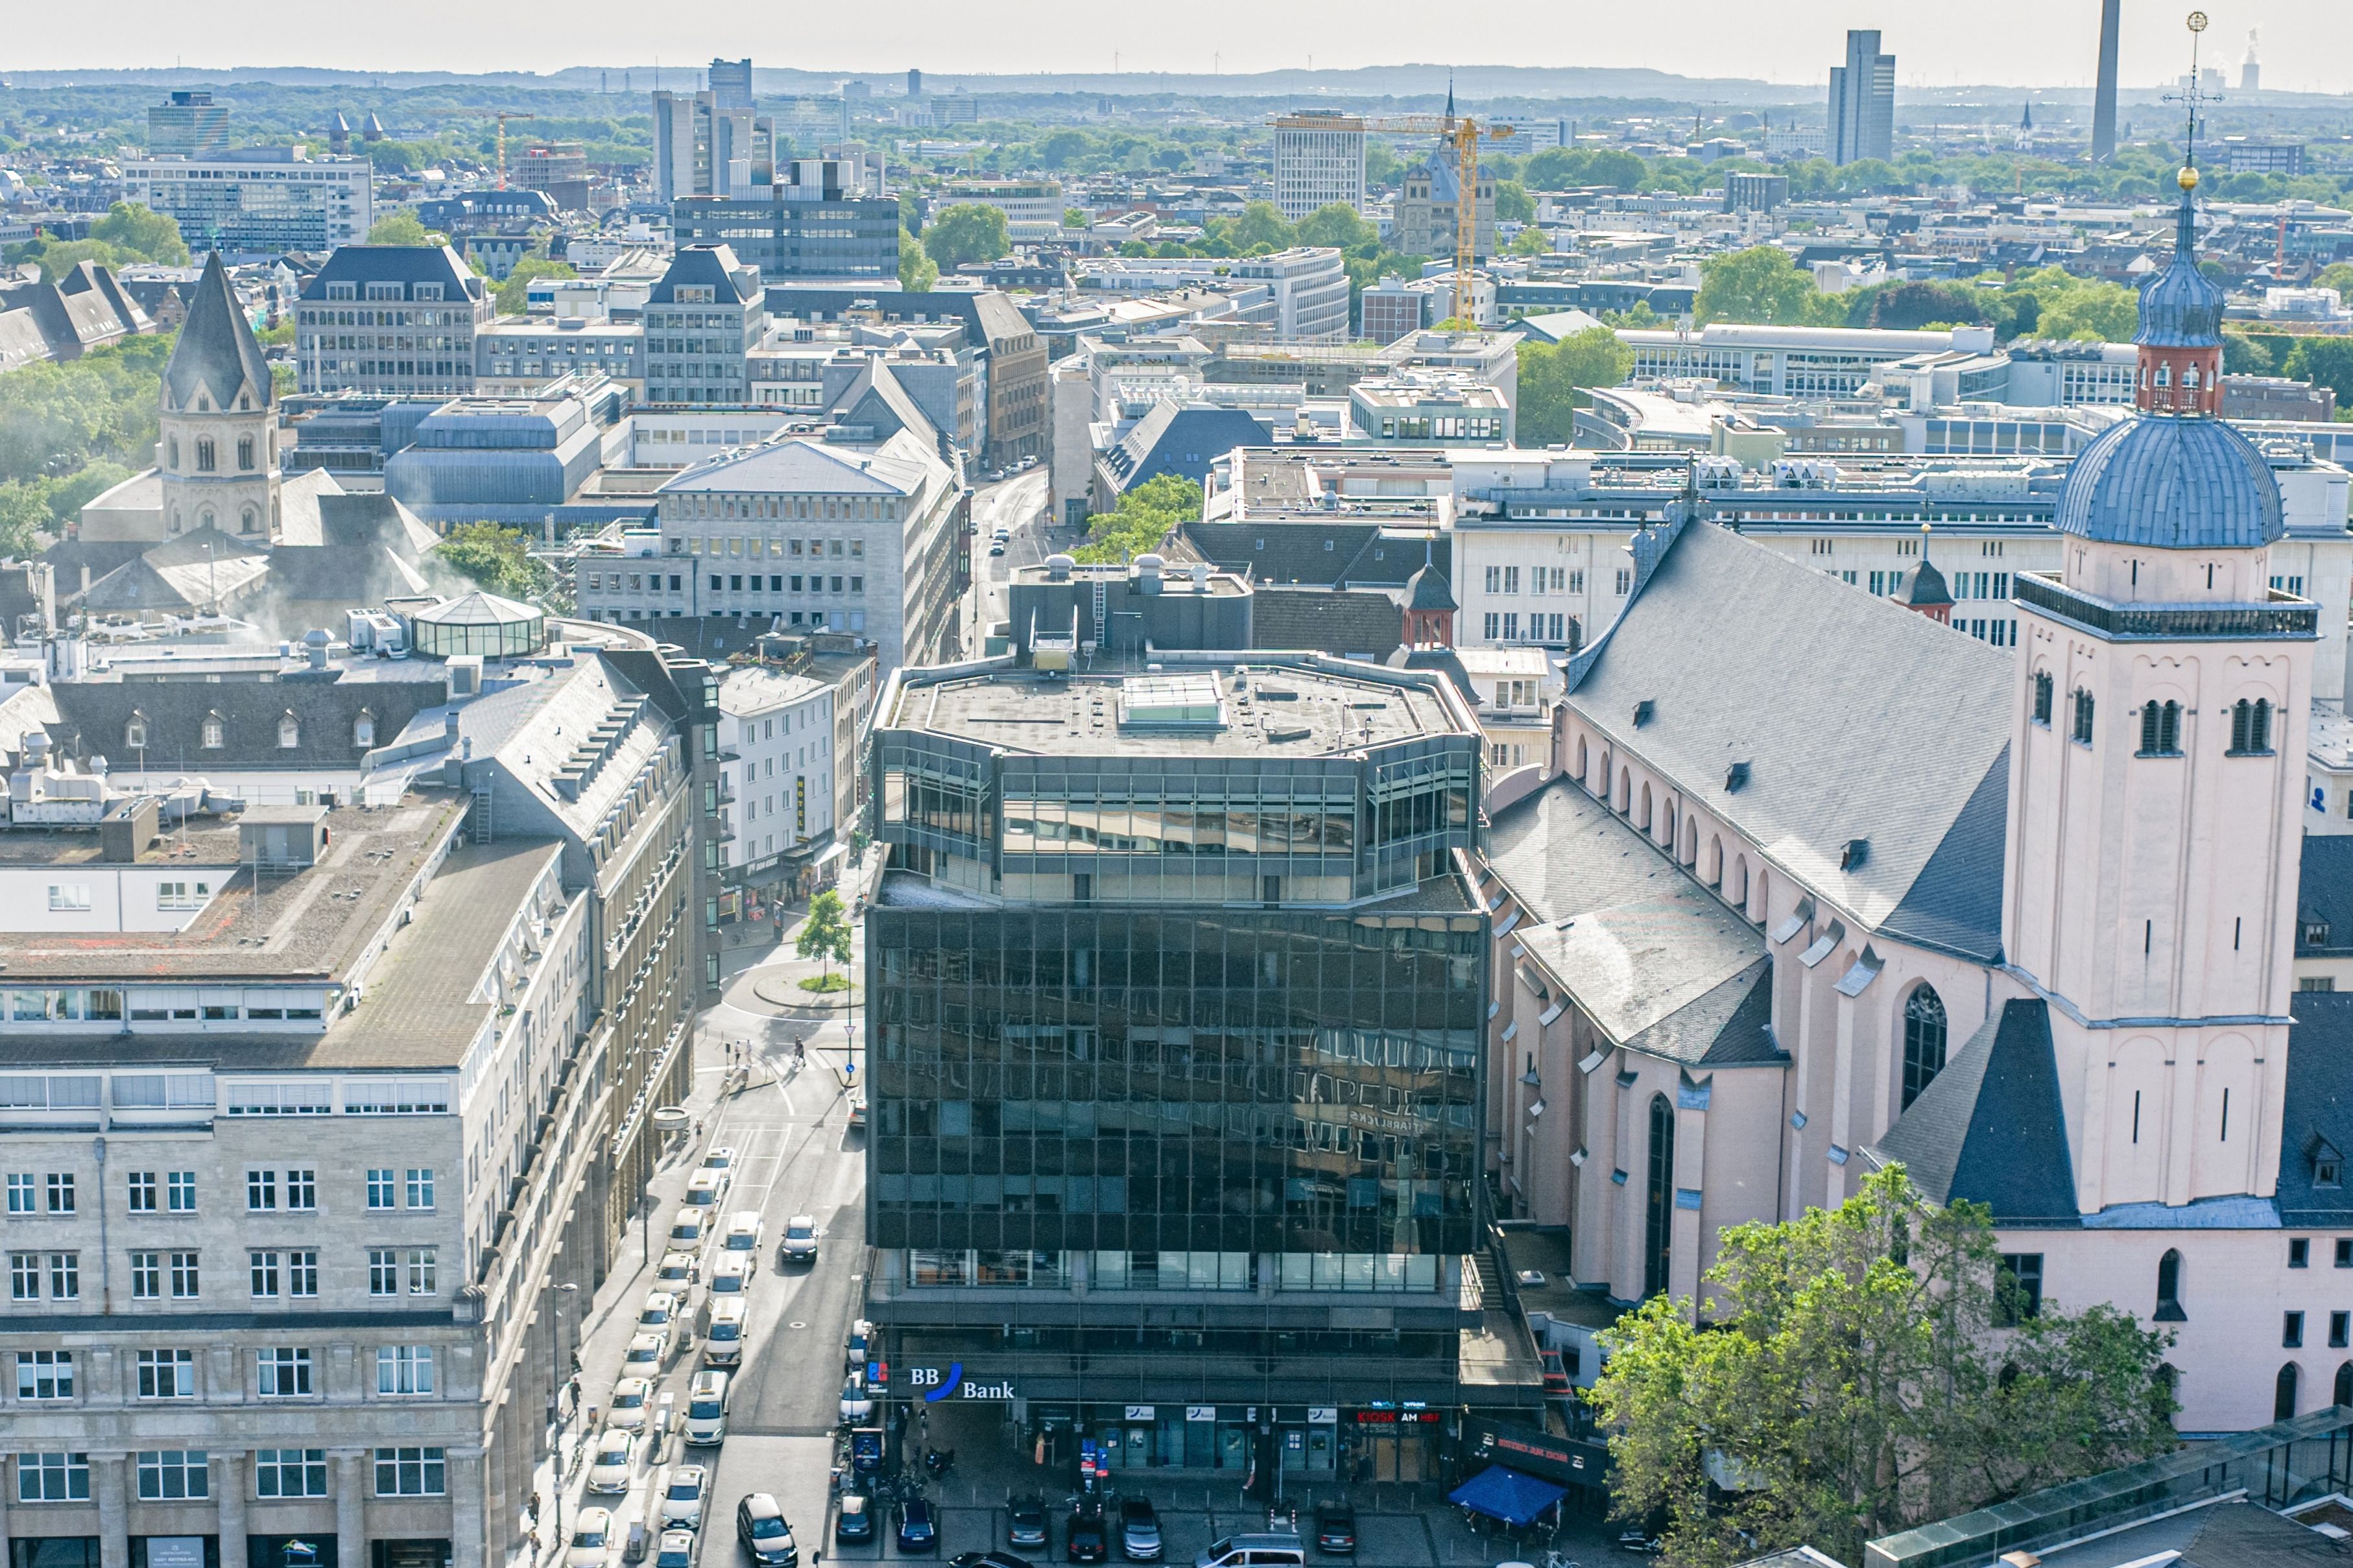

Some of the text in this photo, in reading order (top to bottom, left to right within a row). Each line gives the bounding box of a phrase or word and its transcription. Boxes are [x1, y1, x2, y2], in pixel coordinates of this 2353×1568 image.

[911, 1368, 1015, 1399] BB Bank
[1357, 1412, 1396, 1422] KIOSK
[1401, 1412, 1418, 1422] AM
